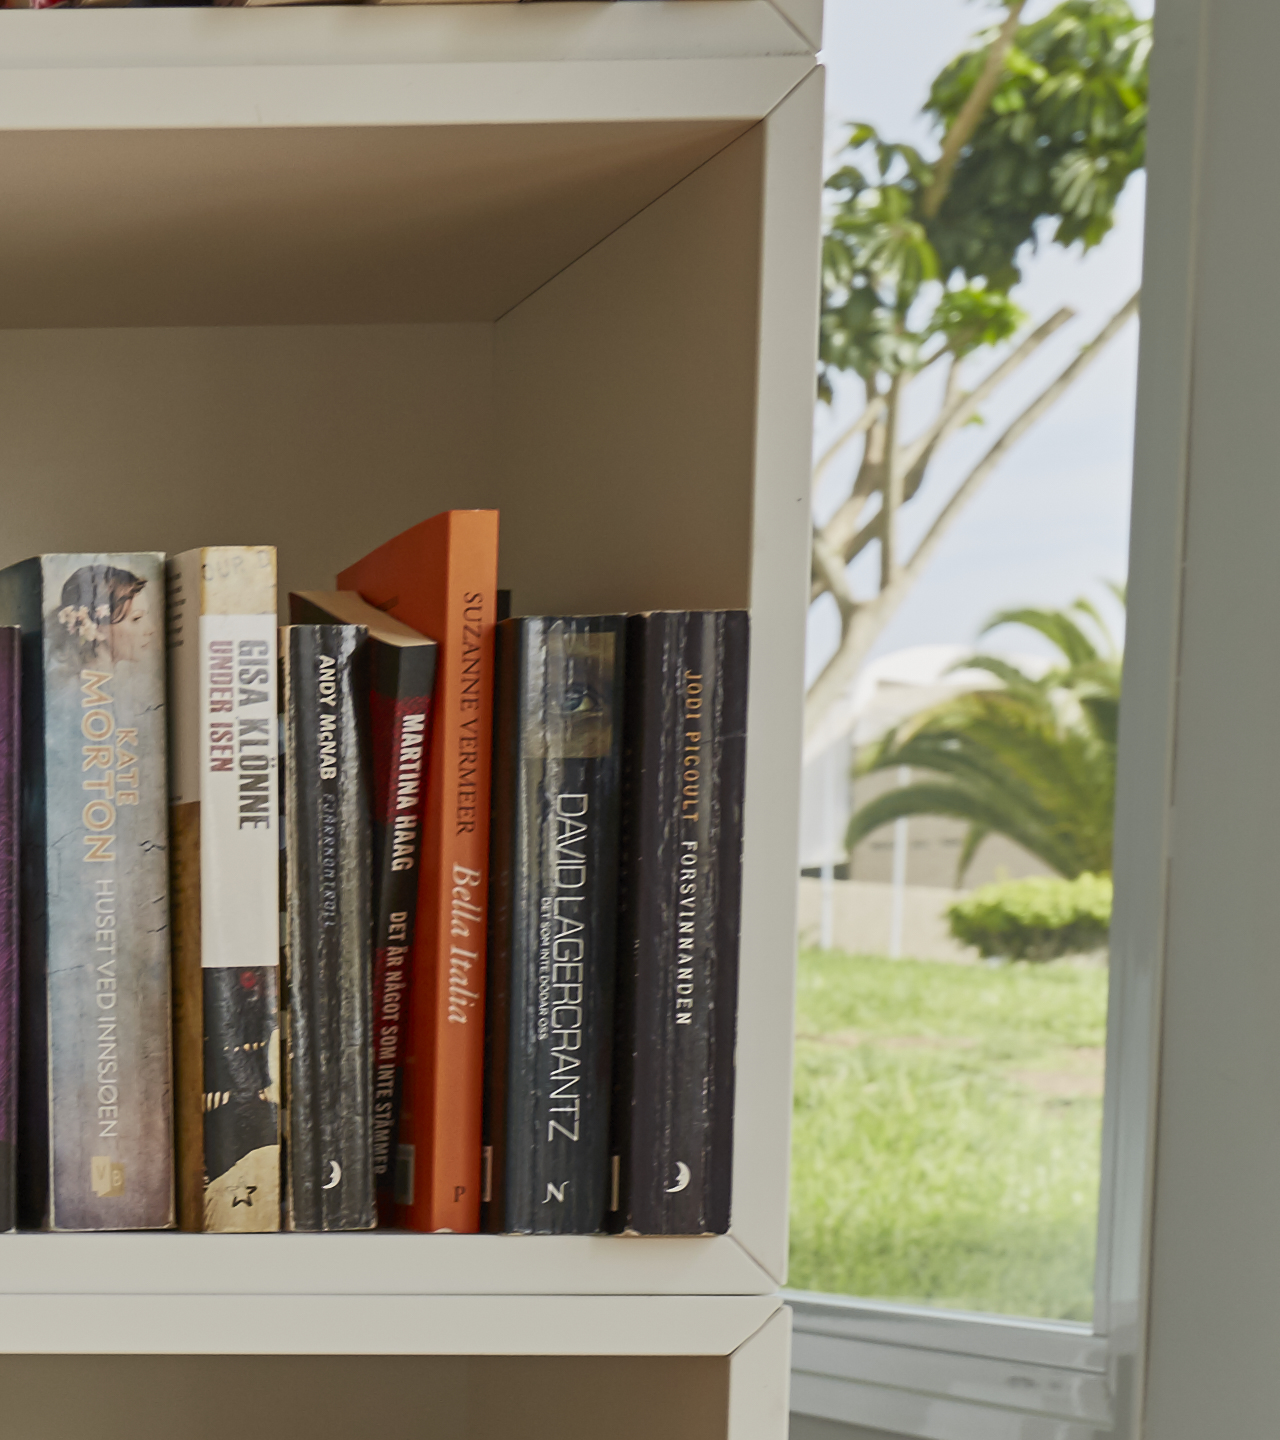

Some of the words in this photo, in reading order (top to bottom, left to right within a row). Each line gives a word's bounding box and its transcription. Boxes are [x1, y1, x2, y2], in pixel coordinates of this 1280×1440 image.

[318, 654, 337, 710] ANDY
[460, 591, 484, 709] SUZANNE
[318, 714, 337, 781] McNAB
[457, 713, 481, 837] VERMEER
[554, 793, 588, 890] DAVID
[450, 862, 480, 940] Bella
[446, 944, 478, 1025] Italia
[548, 894, 586, 1143] LAGERCRANTZ
